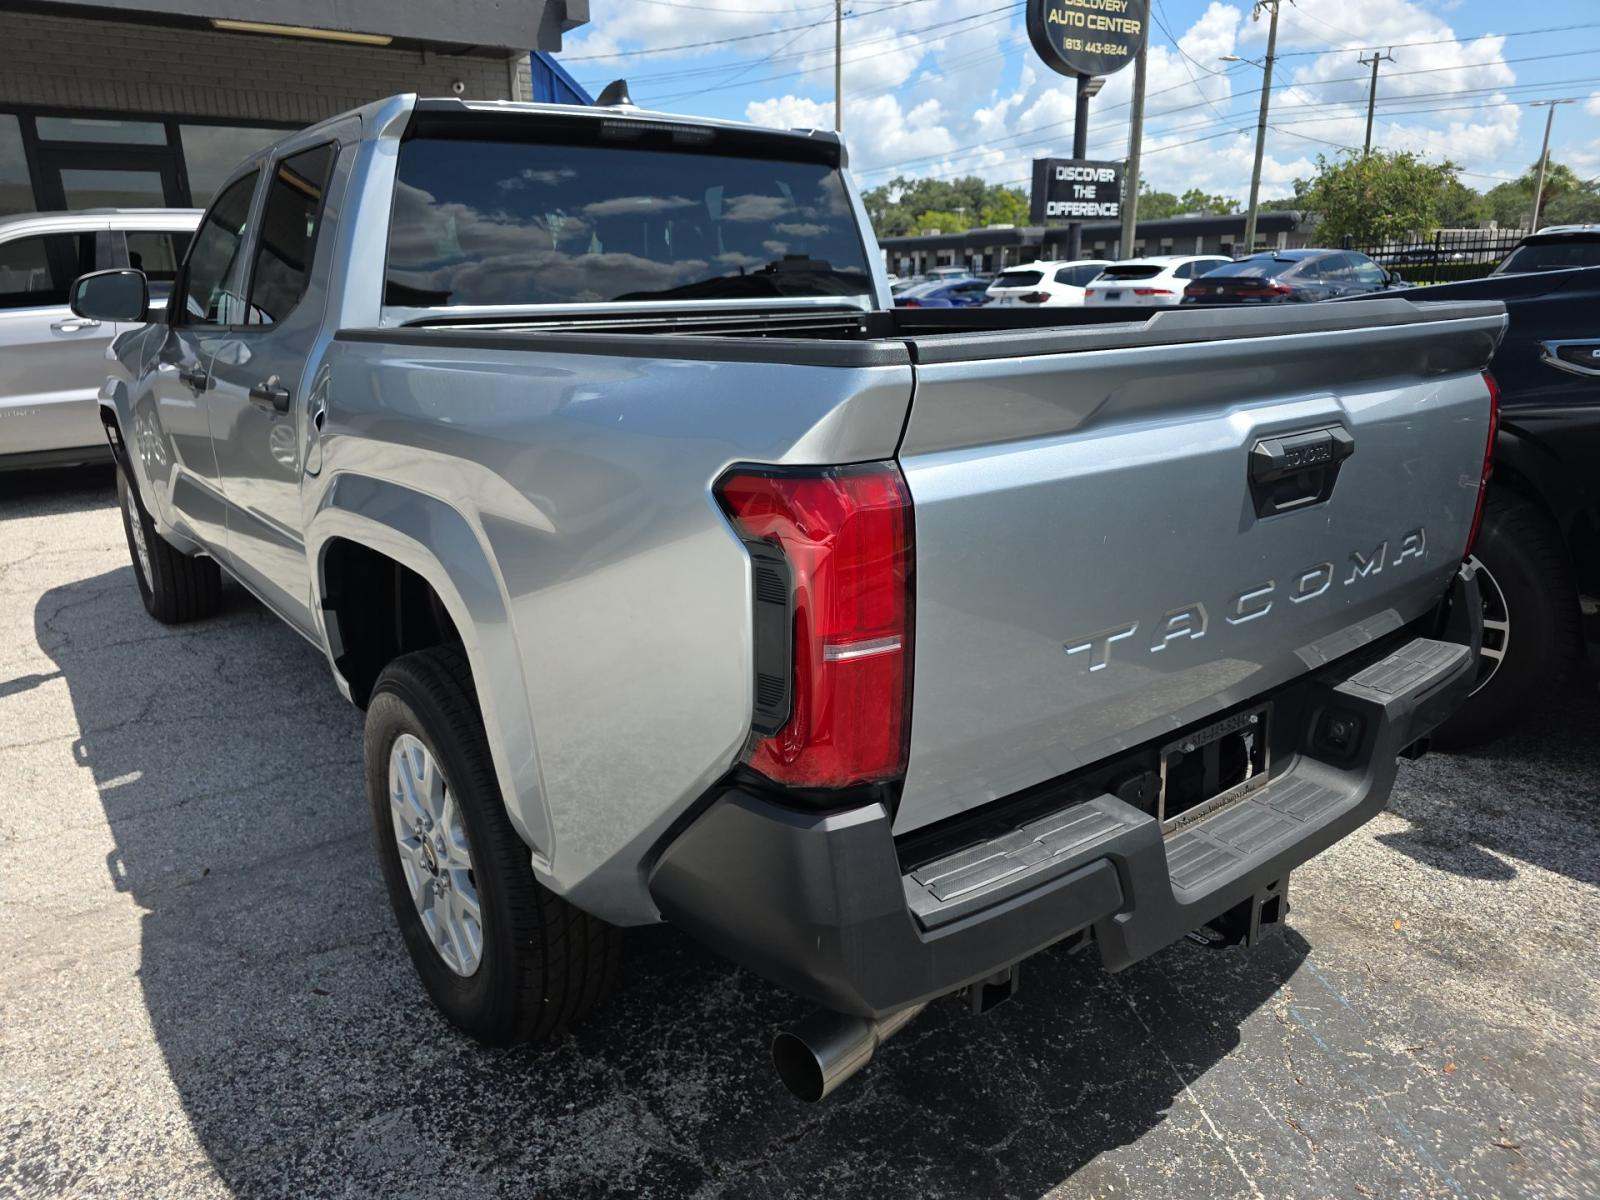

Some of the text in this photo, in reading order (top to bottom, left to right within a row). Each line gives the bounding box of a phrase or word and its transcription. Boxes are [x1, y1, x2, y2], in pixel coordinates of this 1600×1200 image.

[1048, 9, 1141, 34] AUTO CENTER
[1085, 41, 1128, 56] 443-8244
[1056, 166, 1116, 182] DISCOVER
[1073, 184, 1097, 199] THE
[1046, 201, 1119, 216] DIFFERENCE
[1064, 527, 1426, 672] TACOMA
